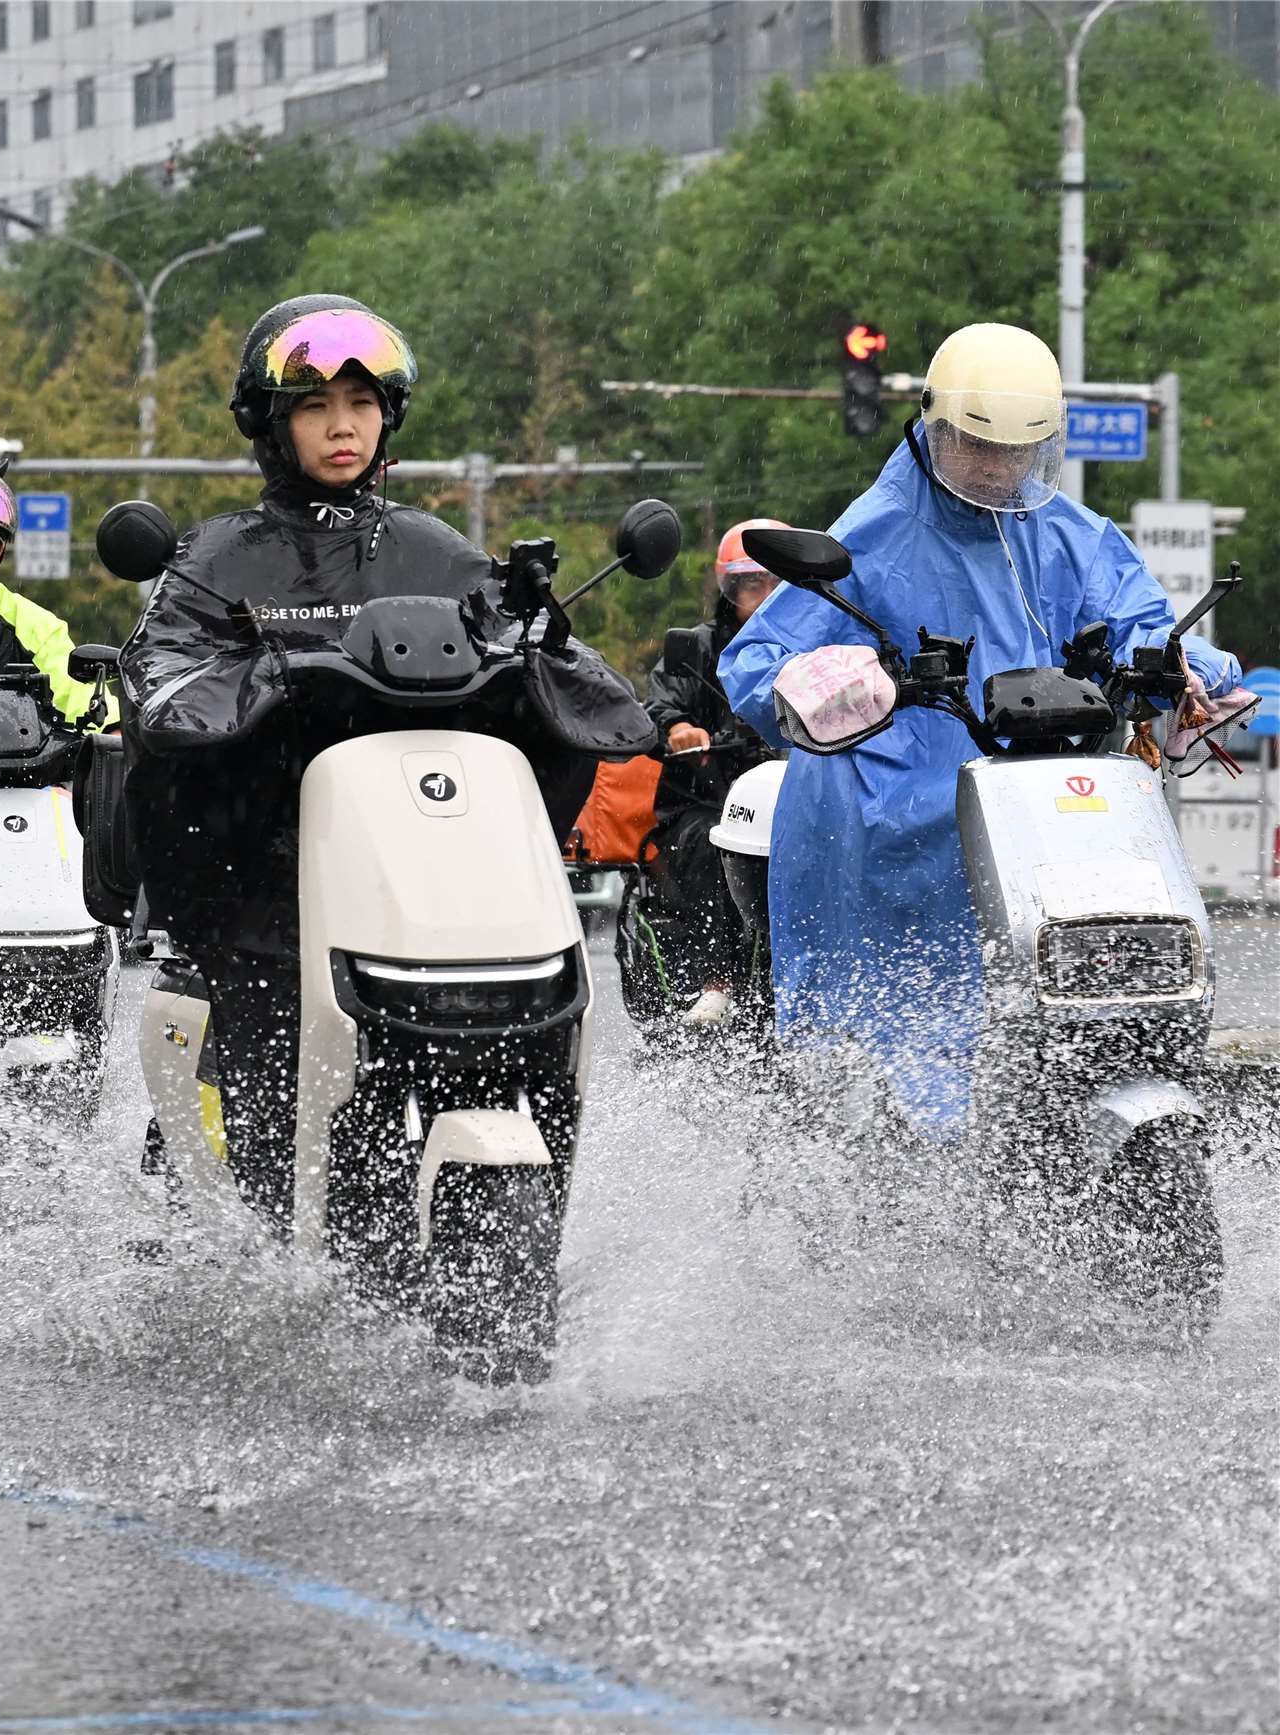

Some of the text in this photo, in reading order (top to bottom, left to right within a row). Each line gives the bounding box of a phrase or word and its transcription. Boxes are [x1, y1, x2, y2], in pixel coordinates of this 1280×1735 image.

[290, 608, 310, 620] TO
[313, 605, 340, 619] ME,
[341, 604, 362, 617] EM
[727, 803, 756, 823] SUPIN
